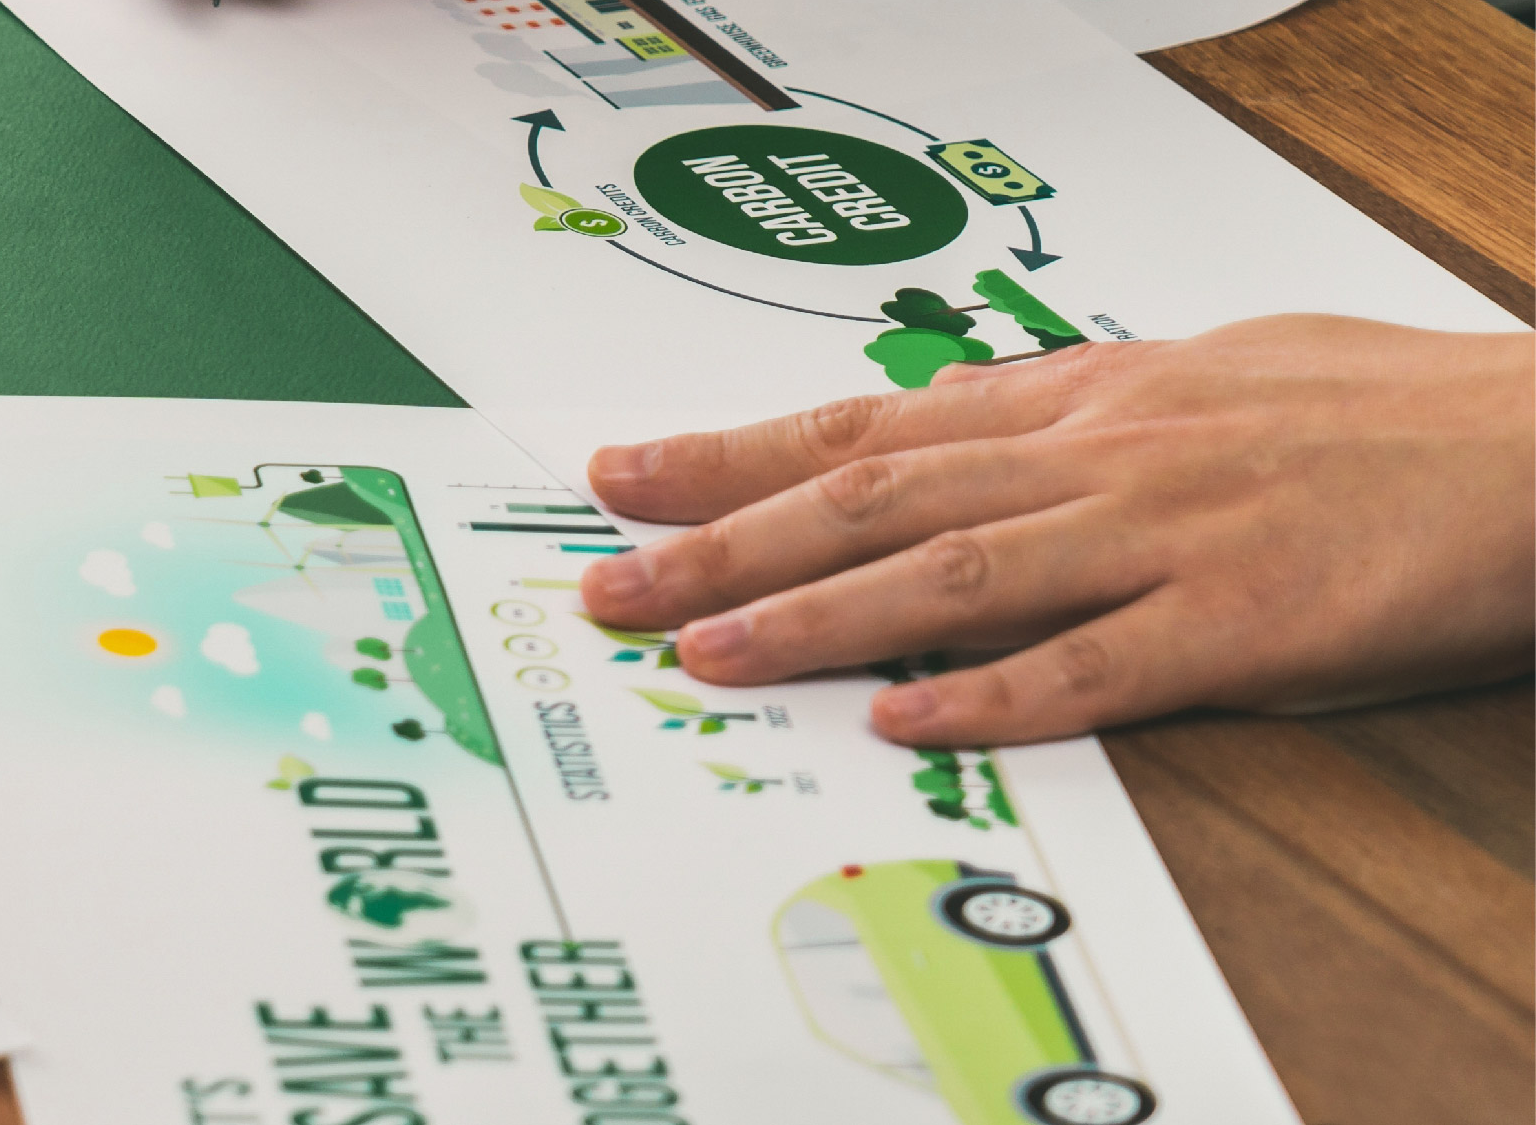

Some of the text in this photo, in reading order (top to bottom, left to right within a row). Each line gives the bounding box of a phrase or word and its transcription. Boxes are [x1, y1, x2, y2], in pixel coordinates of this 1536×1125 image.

[594, 183, 687, 246] CARBON CREDITS
[681, 153, 838, 247] CARBON
[766, 153, 912, 232] CREDIT
[1087, 313, 1143, 343] RATION
[532, 700, 611, 801] STATISTICS
[421, 1002, 517, 1063] THE
